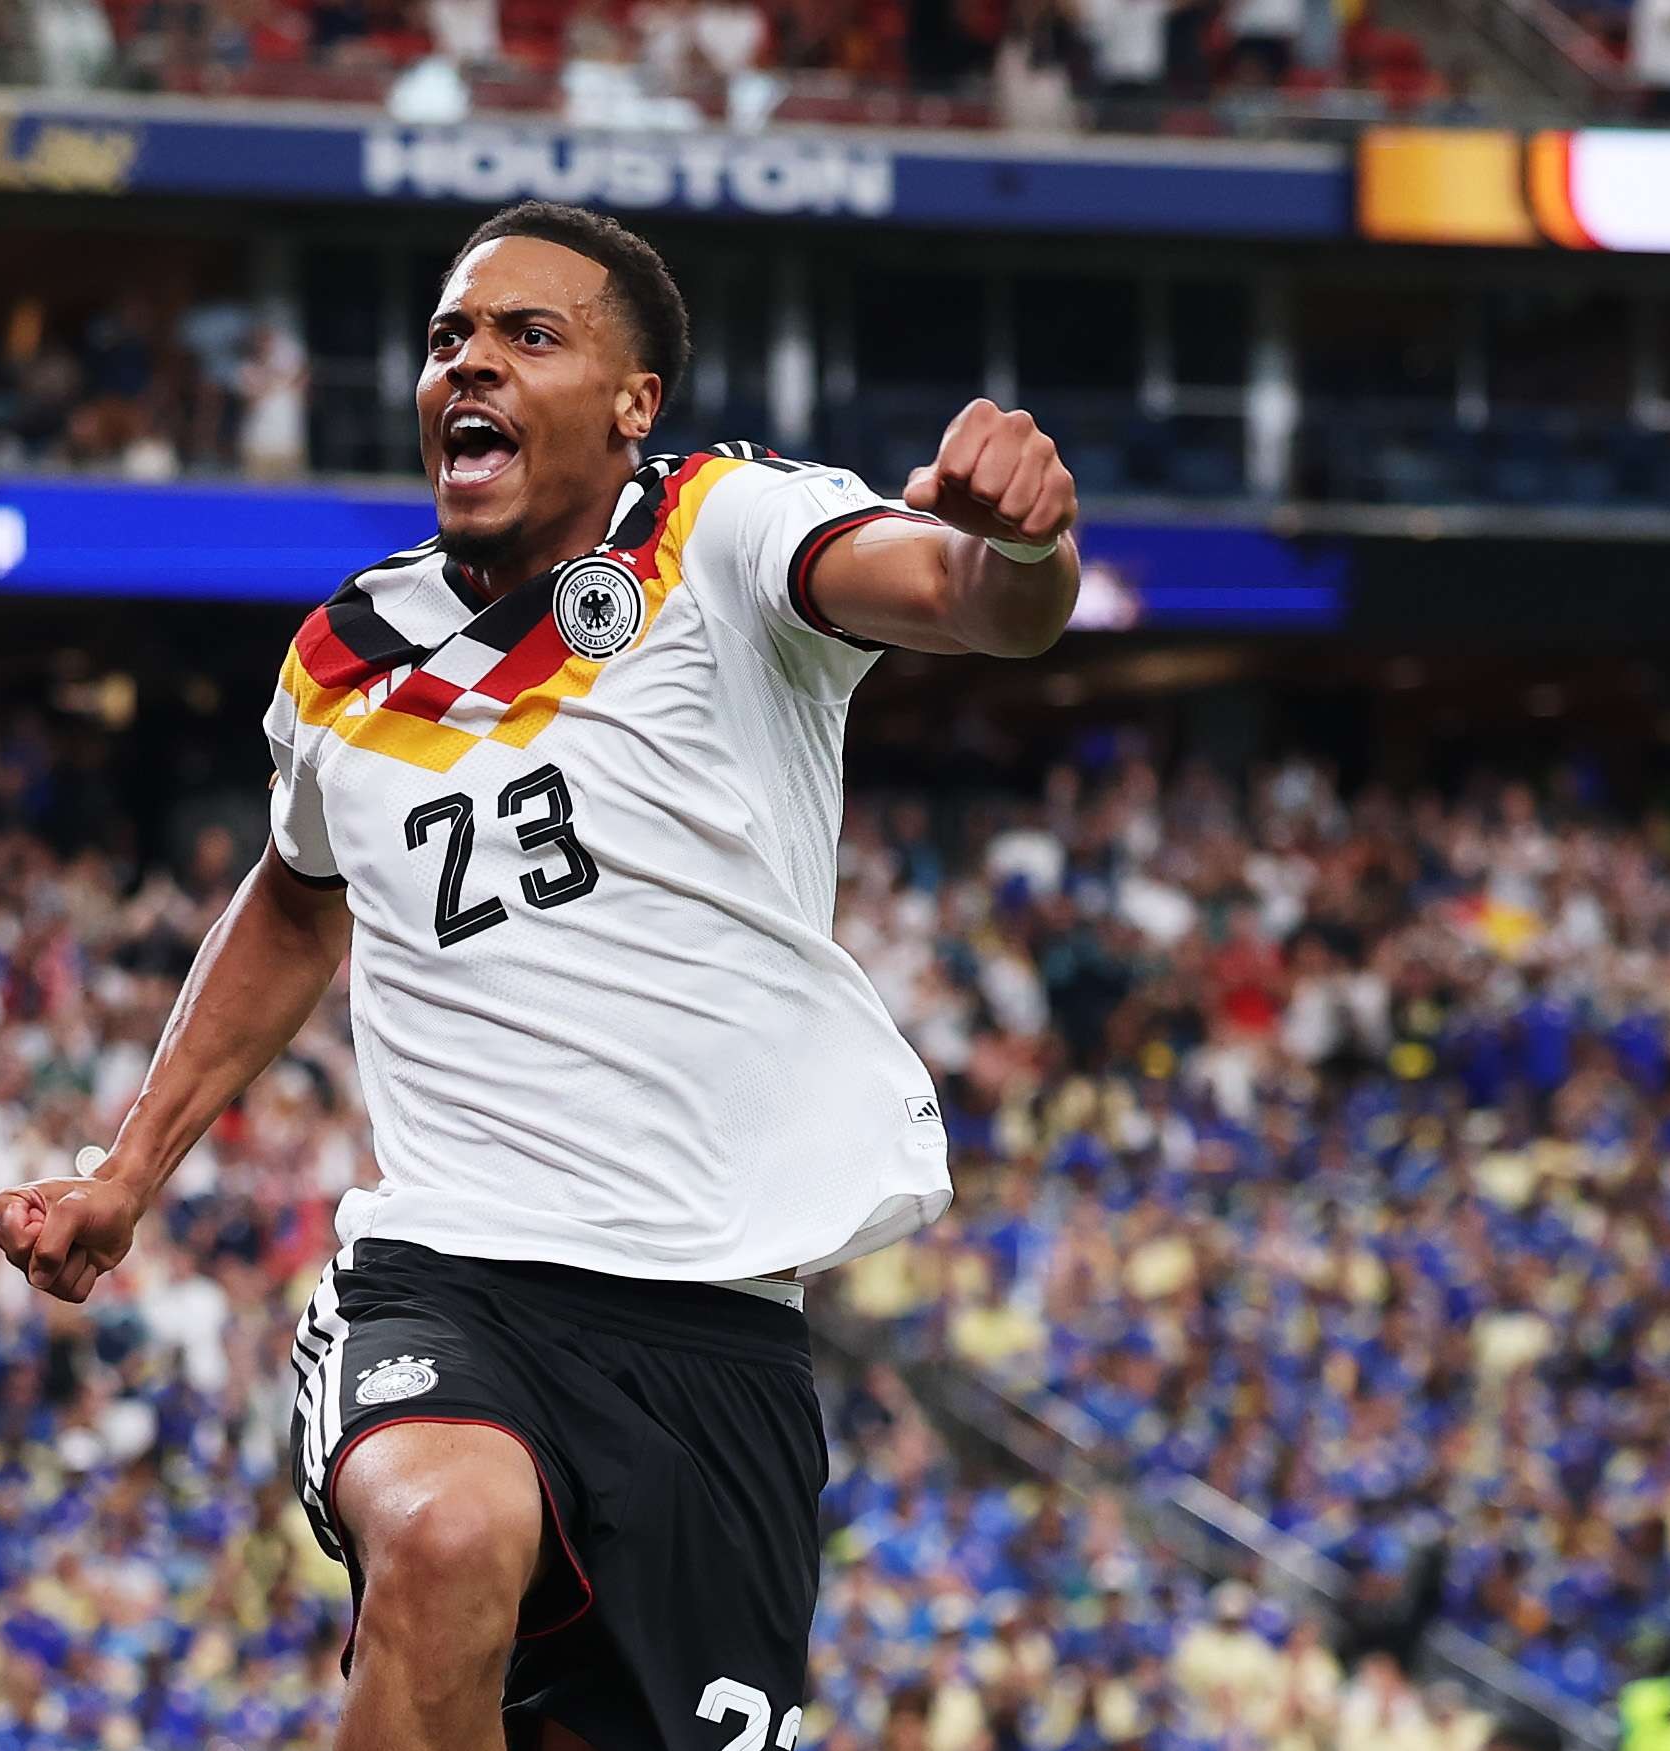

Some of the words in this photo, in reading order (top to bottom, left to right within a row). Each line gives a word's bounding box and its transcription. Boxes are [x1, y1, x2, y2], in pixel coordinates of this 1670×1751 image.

[362, 126, 894, 217] HOUSTON
[570, 574, 619, 596] DEUTSCHER
[570, 615, 628, 647] FUSSBALL-BUND
[404, 763, 600, 949] 23
